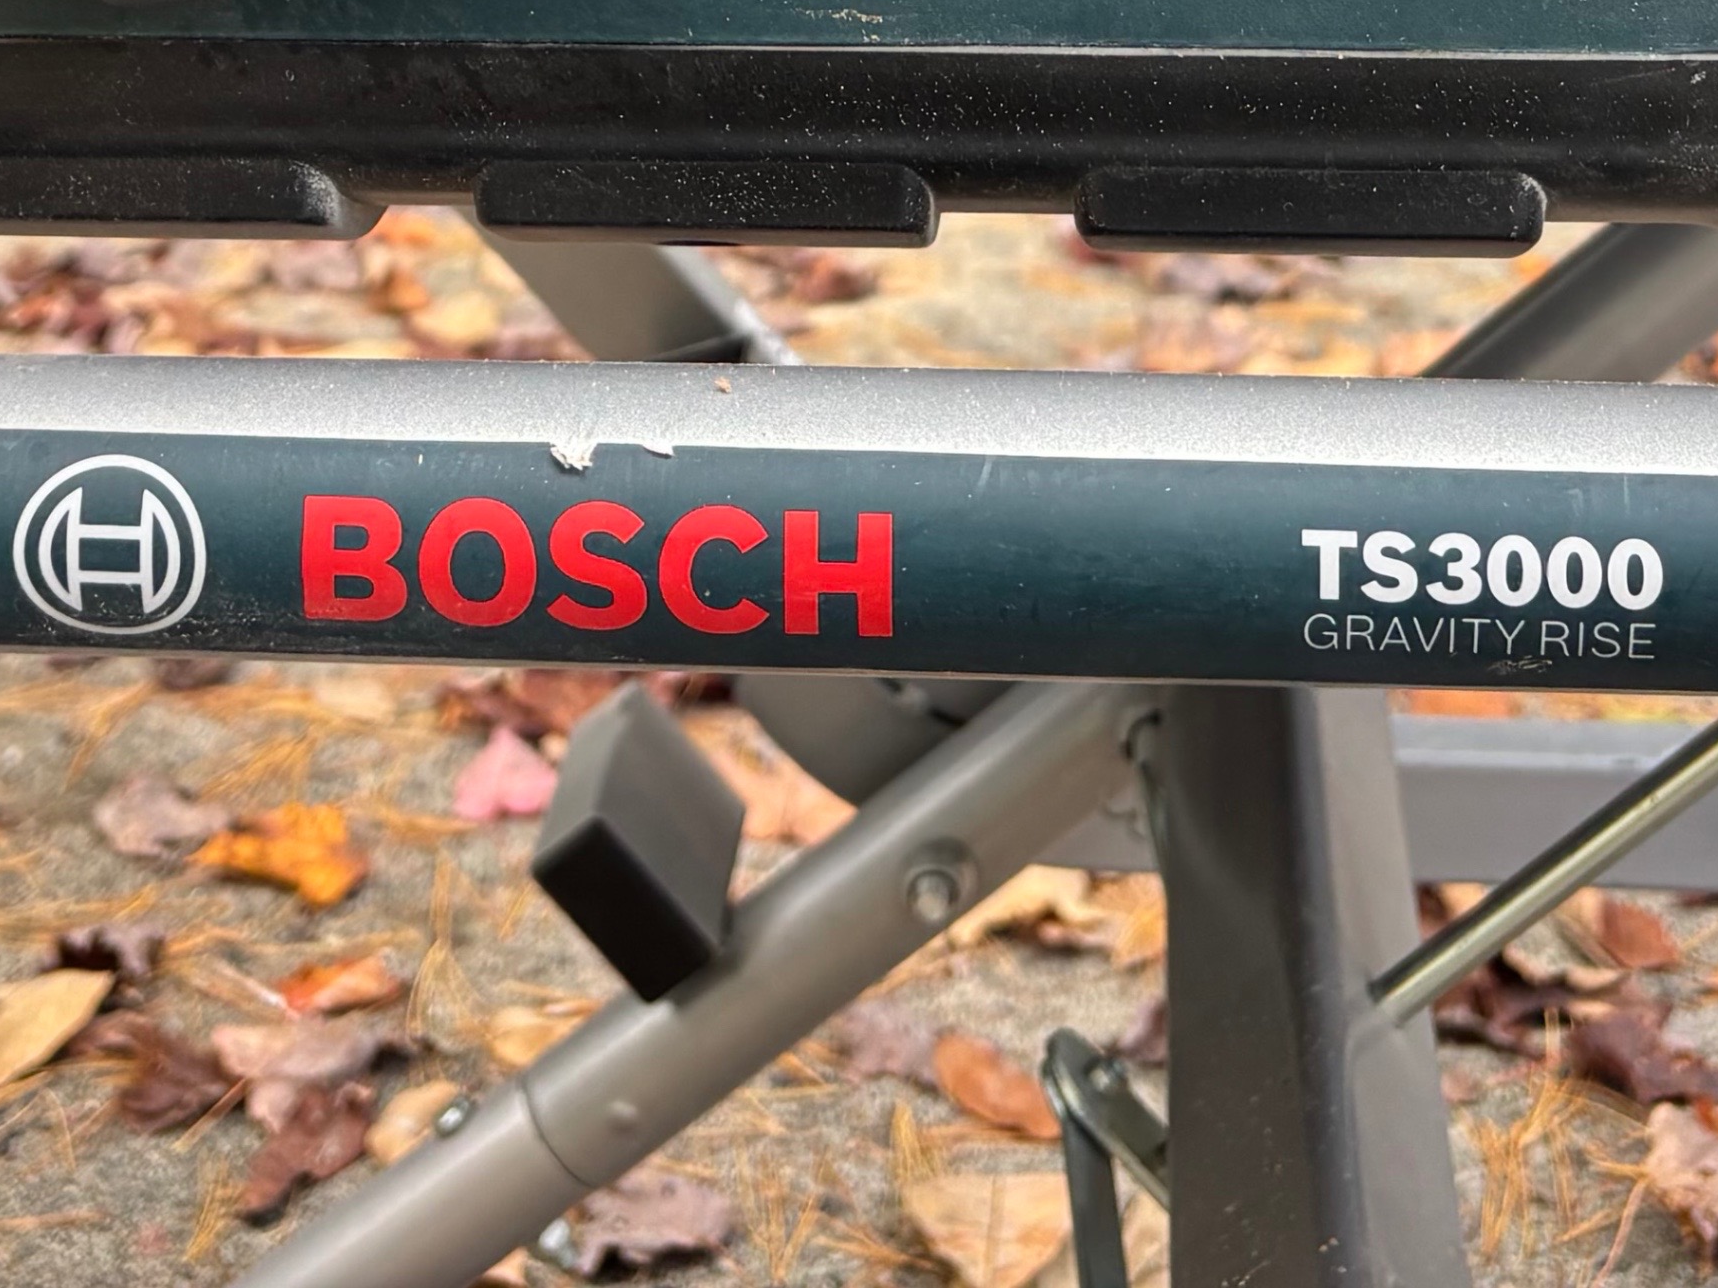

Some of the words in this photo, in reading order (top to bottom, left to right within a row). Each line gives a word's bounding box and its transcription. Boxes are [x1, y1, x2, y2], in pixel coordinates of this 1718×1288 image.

[301, 495, 893, 638] BOSCH
[1301, 529, 1664, 611] TS3000
[1303, 613, 1526, 655] GRAVITY
[1540, 620, 1656, 659] RISE
